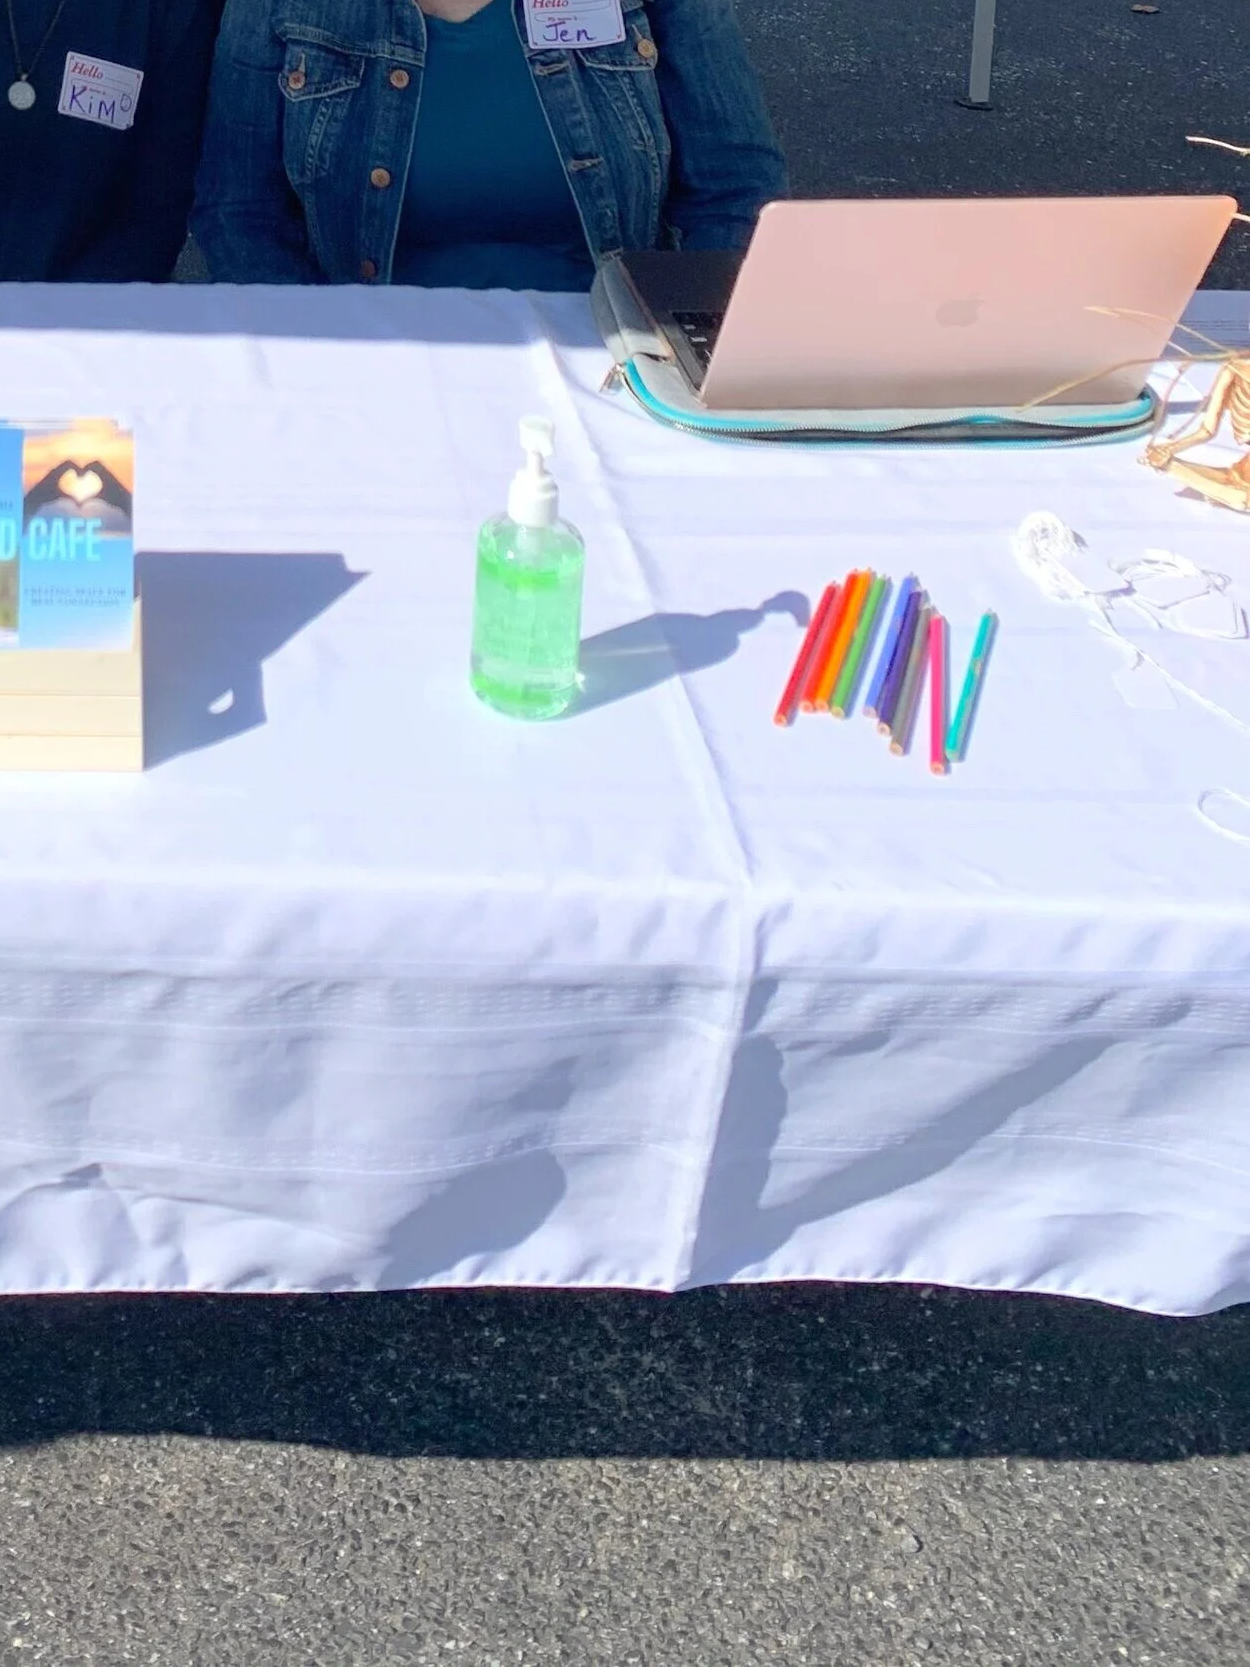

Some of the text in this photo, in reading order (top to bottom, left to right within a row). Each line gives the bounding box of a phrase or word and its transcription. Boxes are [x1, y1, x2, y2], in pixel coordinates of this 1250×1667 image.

[543, 21, 597, 42] Jen
[71, 62, 104, 79] Hello
[29, 517, 103, 561] CAFE
